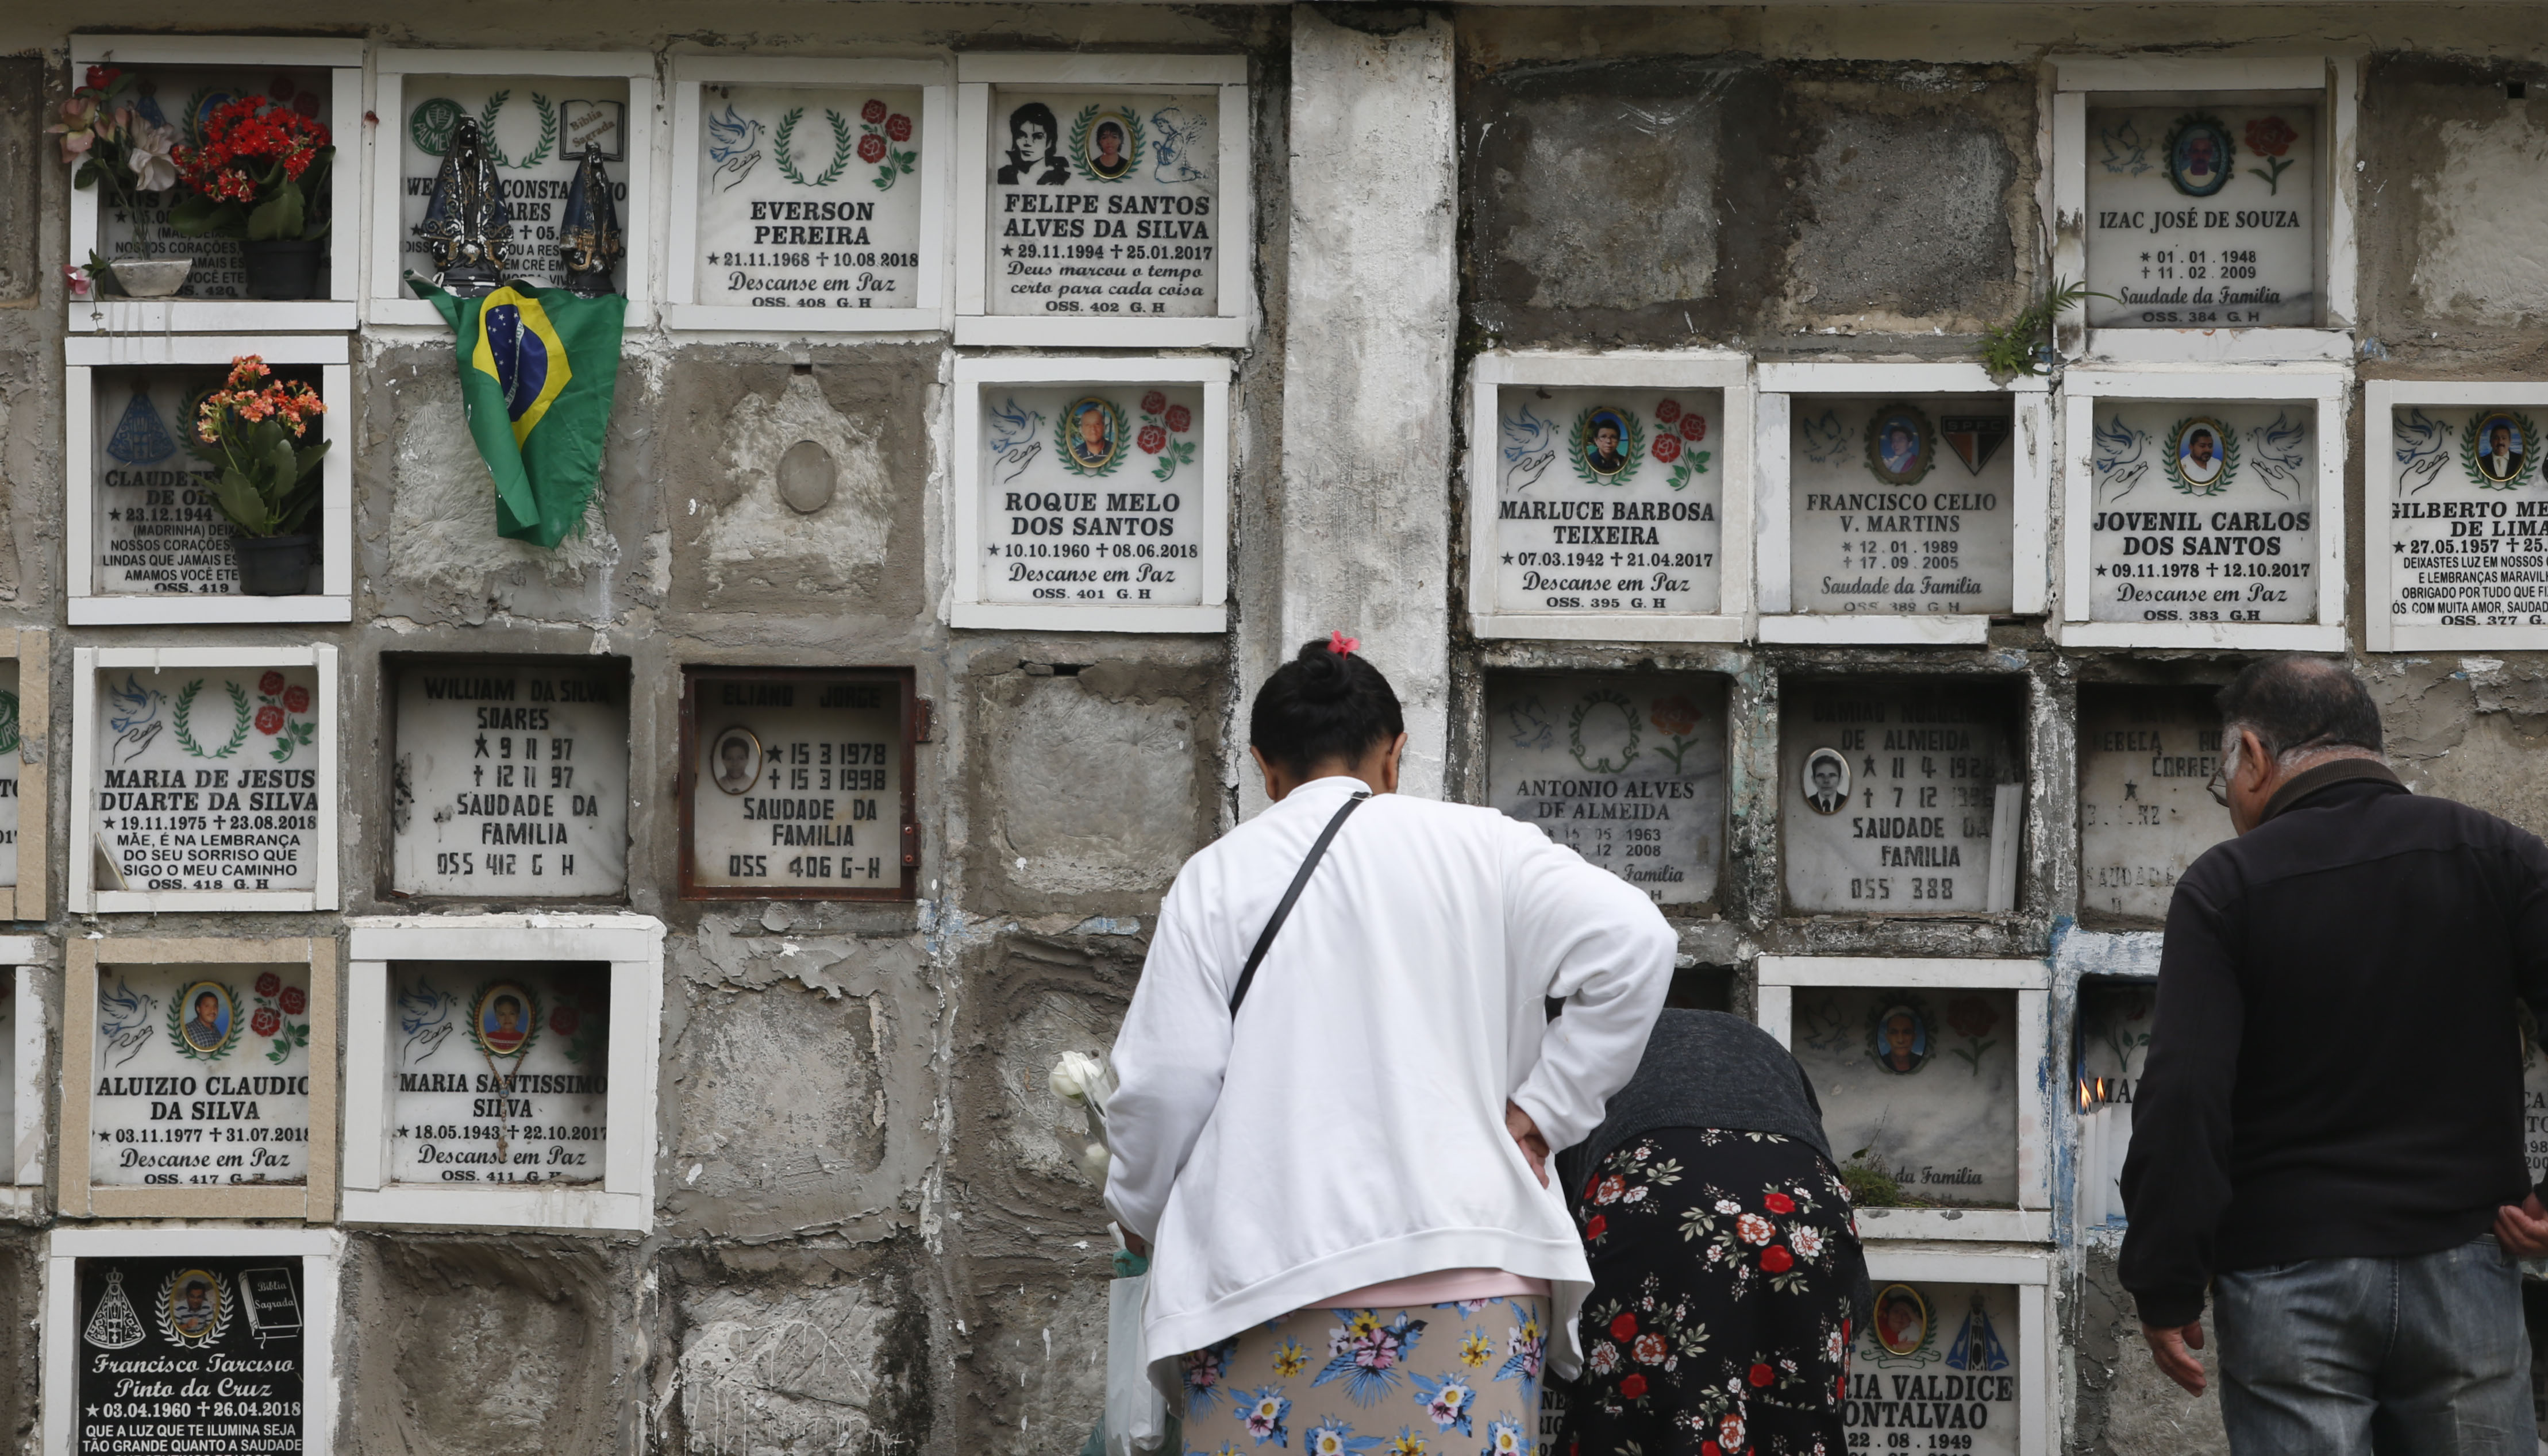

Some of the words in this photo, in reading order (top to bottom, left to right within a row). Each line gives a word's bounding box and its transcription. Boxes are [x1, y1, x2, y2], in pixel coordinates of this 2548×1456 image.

[750, 202, 874, 221] EVERSON
[1004, 194, 1099, 214] FELIPE
[1109, 195, 1210, 215] SANTOS
[1003, 219, 1084, 237] ALVES
[1094, 219, 1127, 237] DA
[1137, 220, 1208, 239] SILVA
[2099, 211, 2144, 229] IZAC
[2150, 207, 2198, 234] JOSÉ
[2204, 211, 2230, 228] DE
[2235, 211, 2300, 228] SOUZA
[754, 226, 870, 245] PEREIRA
[724, 252, 810, 267] 21.11.1968
[834, 253, 918, 267] 10.08.2018
[1018, 244, 1104, 259] 29.11.1994
[1127, 246, 1213, 260] 25.01.2017
[728, 271, 818, 291] Descanse
[823, 279, 850, 291] em
[856, 272, 896, 291] Paz
[1007, 261, 1052, 275] Deus
[1059, 267, 1127, 276] marcou
[1133, 268, 1143, 276] o
[1148, 265, 1203, 282] tempo
[752, 297, 789, 307] OSS.
[797, 298, 825, 307] 408
[859, 298, 871, 307] H
[2120, 287, 2188, 305] Saudade
[2193, 287, 2214, 305] da
[2219, 287, 2281, 305] Familia
[1005, 493, 1097, 511] ROQUE
[1106, 493, 1180, 513] MELO
[1499, 501, 1604, 520] MARLUCE
[1612, 502, 1714, 521] BARBOSA
[1807, 494, 1927, 511] FRANCISCO
[1934, 494, 1996, 511] CELIO
[126, 508, 213, 522] 23.12.1944
[1866, 515, 1960, 532] MARTINS
[2093, 513, 2201, 531] JOVENIL
[2212, 512, 2310, 531] CARLOS
[1011, 517, 1064, 535] DOS
[1073, 517, 1173, 536] SANTOS
[1553, 526, 1659, 545] TEIXEIRA
[111, 540, 160, 551] NOSSOS
[164, 539, 233, 554] CORAÇÕES,
[1005, 544, 1090, 557] 10.10.1960
[1113, 544, 1198, 558] 08.06.2018
[2123, 537, 2174, 555] DOS
[2183, 537, 2281, 556] SANTOS
[2411, 540, 2499, 554] 27.05.1957
[1518, 552, 1604, 567] 07.03.1942
[1627, 553, 1713, 567] 21.04.2017
[2404, 556, 2459, 569] DEIXASTES
[2462, 556, 2481, 568] LUZ
[2484, 556, 2498, 567] EM
[2501, 556, 2543, 567] NOSSOS
[125, 570, 178, 581] AMAMOS
[180, 567, 213, 580] VOCÊ
[1009, 563, 1098, 581] Descanse
[1103, 570, 1130, 582] em
[1136, 563, 1176, 583] Paz
[2112, 564, 2200, 578] 09.11.1978
[2224, 564, 2310, 577] 12.10.2017
[1522, 571, 1612, 591] Descanse
[1618, 578, 1645, 591] em
[1651, 572, 1691, 592] Paz
[1820, 576, 1891, 595] Saudade
[1895, 576, 1915, 594] da
[1920, 576, 1981, 594] Familia
[2117, 583, 2207, 602] Descanse
[2213, 590, 2241, 602] em
[2247, 583, 2288, 602] Paz
[477, 707, 549, 730] SOARES
[104, 770, 186, 788] MARIA
[195, 770, 228, 788] DE
[238, 770, 315, 788] JESUS
[1517, 780, 1618, 798] ANTONIO
[1624, 781, 1695, 799] ALVES
[99, 792, 199, 811] DUARTE
[208, 793, 241, 811] DA
[249, 792, 318, 811] SILVA
[457, 792, 554, 816] SAUDADE
[572, 795, 598, 817] DA
[744, 798, 834, 820] SAUDADE
[853, 799, 877, 821] DA
[1573, 803, 1670, 820] ALMEIDA
[121, 816, 206, 830] 19.11.1975
[230, 816, 317, 830] 23.08.2018
[1853, 817, 1944, 838] SAUDADE
[117, 833, 155, 848] MÃE,
[160, 833, 169, 845] É
[175, 835, 197, 845] NA
[201, 834, 301, 849] LEMBRANÇA
[482, 823, 567, 845] FAMILIA
[772, 824, 854, 846] FAMILIA
[124, 850, 147, 861] DO
[152, 850, 183, 861] SEU
[188, 850, 259, 861] SORRISO
[264, 850, 297, 861] QUE
[1881, 846, 1960, 867] FAMILIA
[124, 865, 163, 876] SIGO
[167, 865, 178, 876] O
[184, 865, 217, 876] MEU
[222, 865, 297, 876] CAMINHO
[1622, 864, 1684, 883] Familia
[1912, 877, 1953, 899] 388
[97, 1077, 197, 1096] ALUIZIO
[399, 1073, 468, 1092] MARIA
[150, 1101, 183, 1120] DA
[191, 1101, 260, 1120] SILVA
[116, 1129, 202, 1142] 03.11.1977
[415, 1125, 500, 1139] 18.05.1943
[120, 1147, 211, 1168] Descanse
[217, 1154, 244, 1166] em
[250, 1147, 290, 1167] Paz
[514, 1151, 540, 1165] em
[546, 1145, 587, 1165] Paz
[1895, 1167, 1914, 1185] da
[1920, 1166, 1983, 1185] Familia
[255, 1298, 295, 1311] Sagrada
[92, 1354, 199, 1373] Francisco
[114, 1378, 175, 1398] Pinto
[180, 1377, 211, 1397] da
[217, 1377, 272, 1397] Cruz
[1892, 1374, 2013, 1401] VALDICE
[103, 1403, 191, 1418] 03.04.1960
[214, 1402, 301, 1416] 26.04.2018
[86, 1425, 114, 1438] QUE
[117, 1425, 126, 1436] A
[129, 1425, 153, 1436] LUZ
[157, 1425, 186, 1438] QUE
[188, 1424, 204, 1436] TE
[207, 1424, 260, 1436] ILUMINA
[263, 1424, 295, 1436] SEJA
[83, 1438, 110, 1452] TÃO
[113, 1439, 168, 1452] GRANDE
[171, 1440, 225, 1452] QUANTO
[228, 1439, 238, 1451] A
[241, 1439, 302, 1451] SAUDADE
